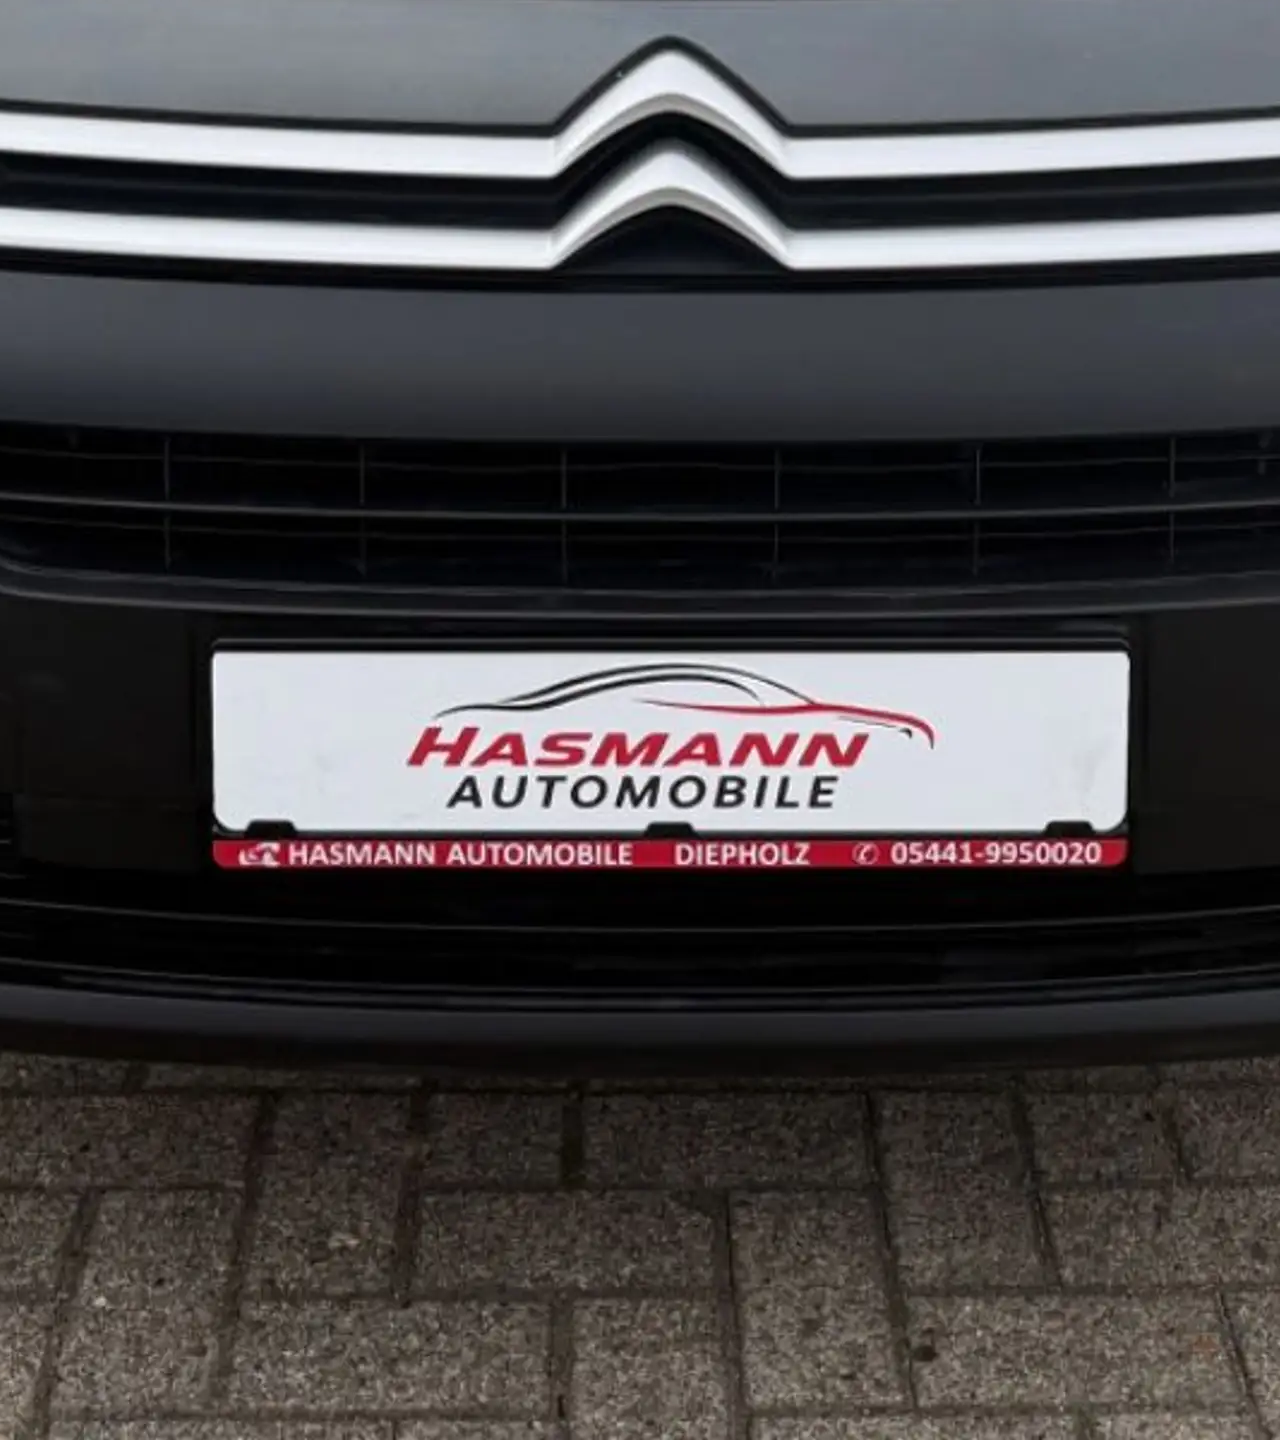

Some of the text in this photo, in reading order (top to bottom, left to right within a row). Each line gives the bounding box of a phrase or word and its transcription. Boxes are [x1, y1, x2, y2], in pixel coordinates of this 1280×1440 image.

[407, 726, 869, 769] HASMANN
[447, 774, 839, 810] AUTOMOBILE
[288, 841, 1102, 866] HASMANN AUTOMOBILE DIEPHOLZ 05441-9950020
